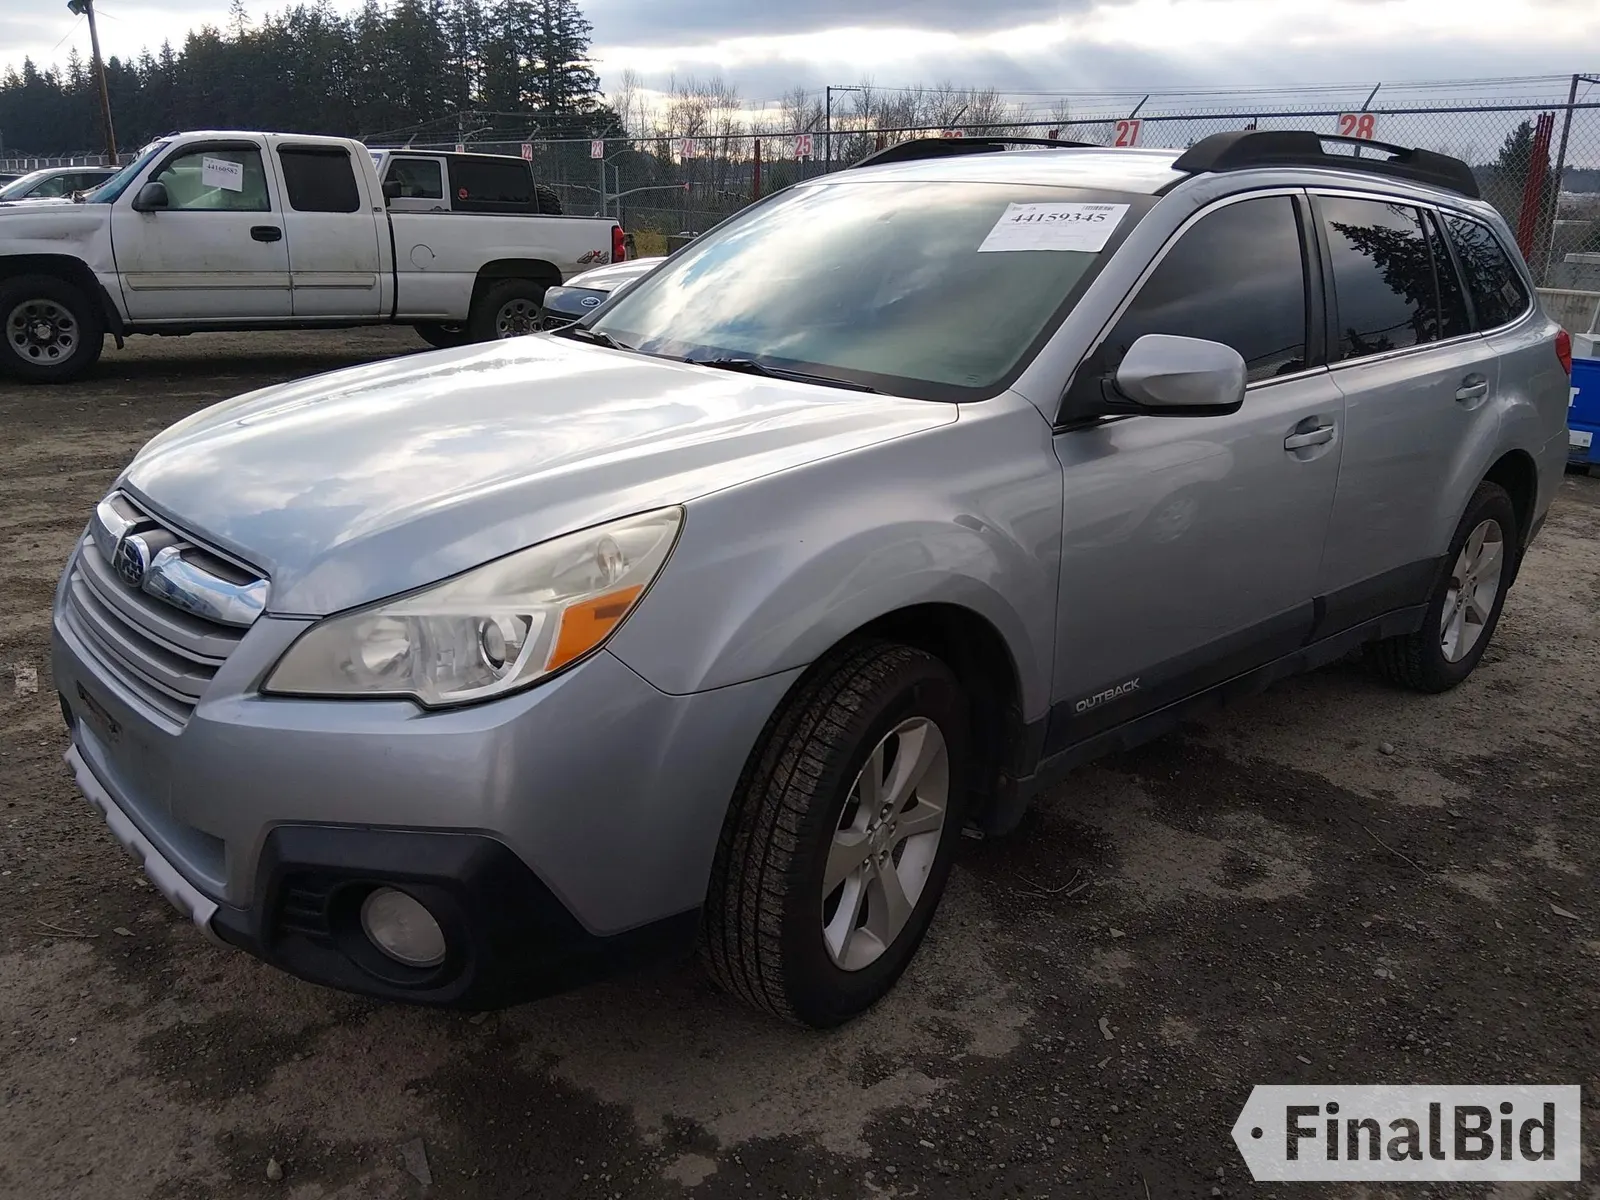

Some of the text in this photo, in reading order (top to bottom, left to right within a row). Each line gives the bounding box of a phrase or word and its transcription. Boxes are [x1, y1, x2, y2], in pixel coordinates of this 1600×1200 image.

[1115, 120, 1140, 147] 27
[1340, 114, 1375, 139] 28
[523, 145, 532, 160] 22
[592, 141, 603, 157] 23
[680, 138, 694, 157] 24
[795, 135, 811, 156] 25
[1011, 212, 1108, 223] 44159345
[1075, 677, 1140, 712] OUTBACK
